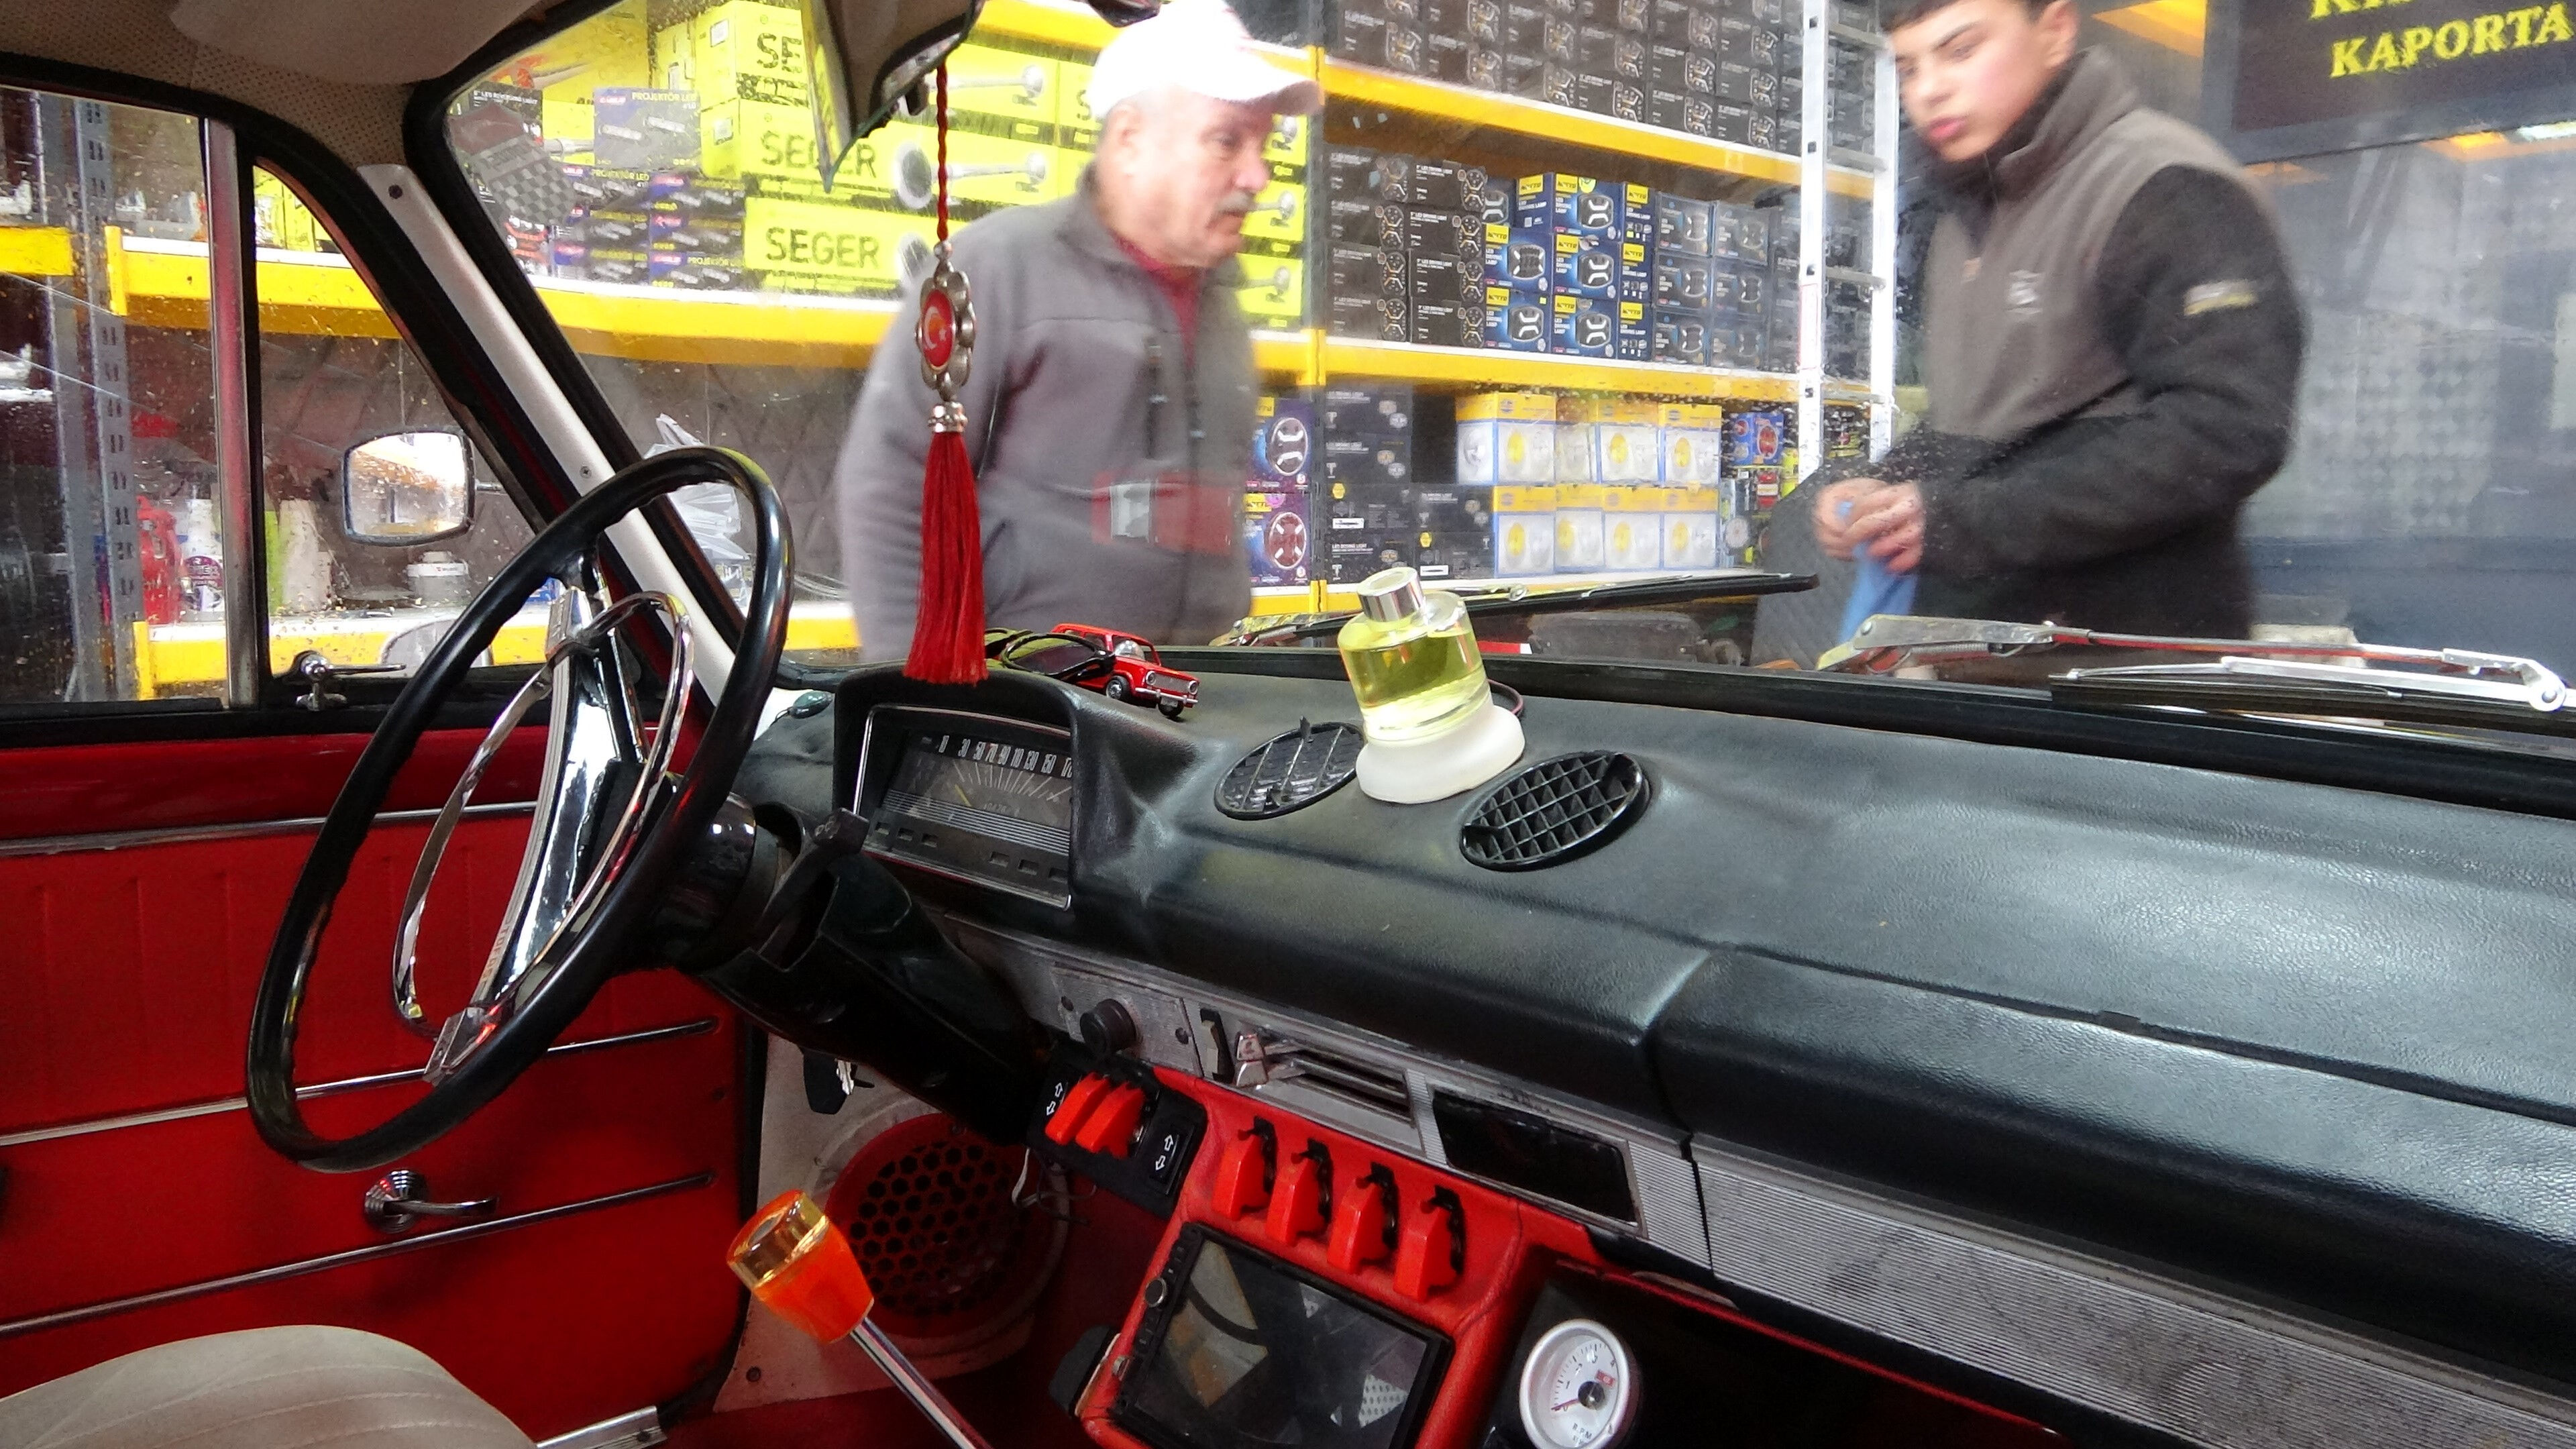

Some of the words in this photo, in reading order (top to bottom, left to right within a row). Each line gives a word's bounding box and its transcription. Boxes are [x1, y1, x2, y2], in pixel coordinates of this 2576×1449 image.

[2330, 2, 2575, 78] KAPORTA
[766, 227, 879, 269] SEGER
[958, 739, 971, 757] 30
[973, 741, 986, 761] 50
[985, 744, 999, 763] 70
[998, 746, 1012, 765] 90
[1010, 748, 1024, 768] 110
[1023, 751, 1040, 771] 130
[1040, 753, 1057, 774] 150
